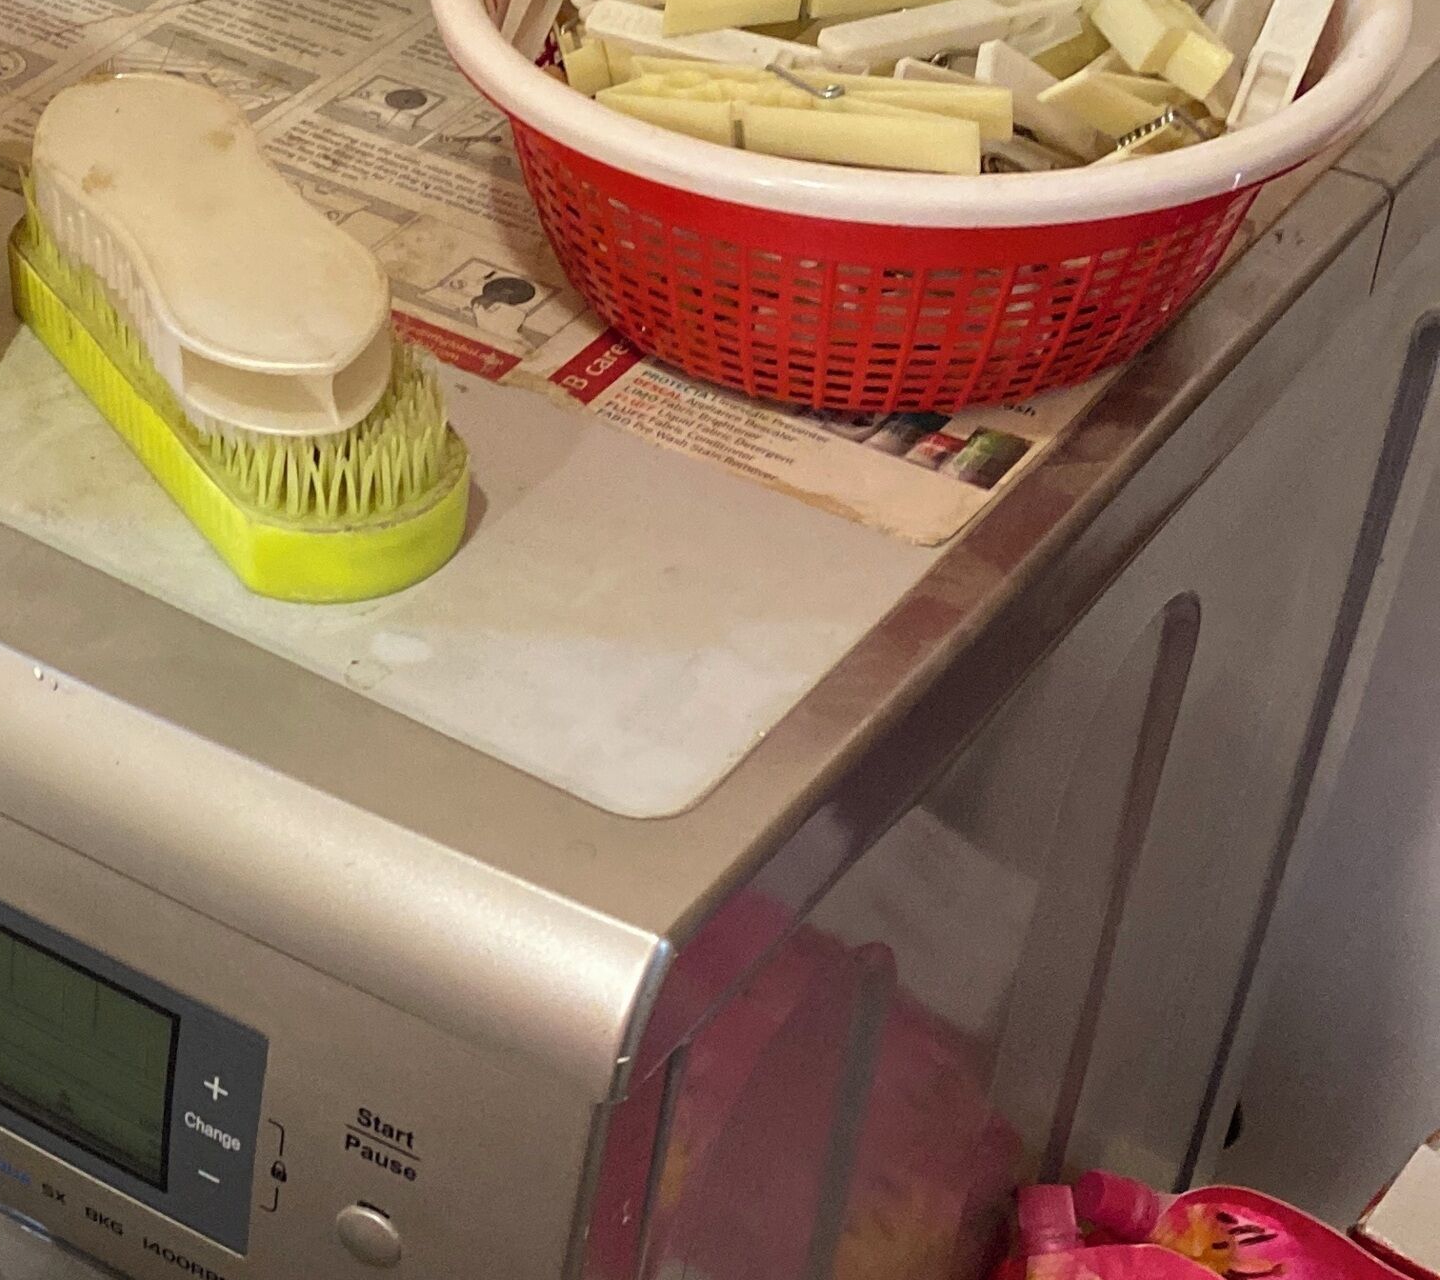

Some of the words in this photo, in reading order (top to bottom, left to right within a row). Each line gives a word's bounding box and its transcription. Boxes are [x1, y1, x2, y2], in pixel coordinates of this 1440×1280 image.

[183, 1110, 242, 1152] Change
[357, 1106, 414, 1151] Start
[344, 1132, 418, 1182] Pause
